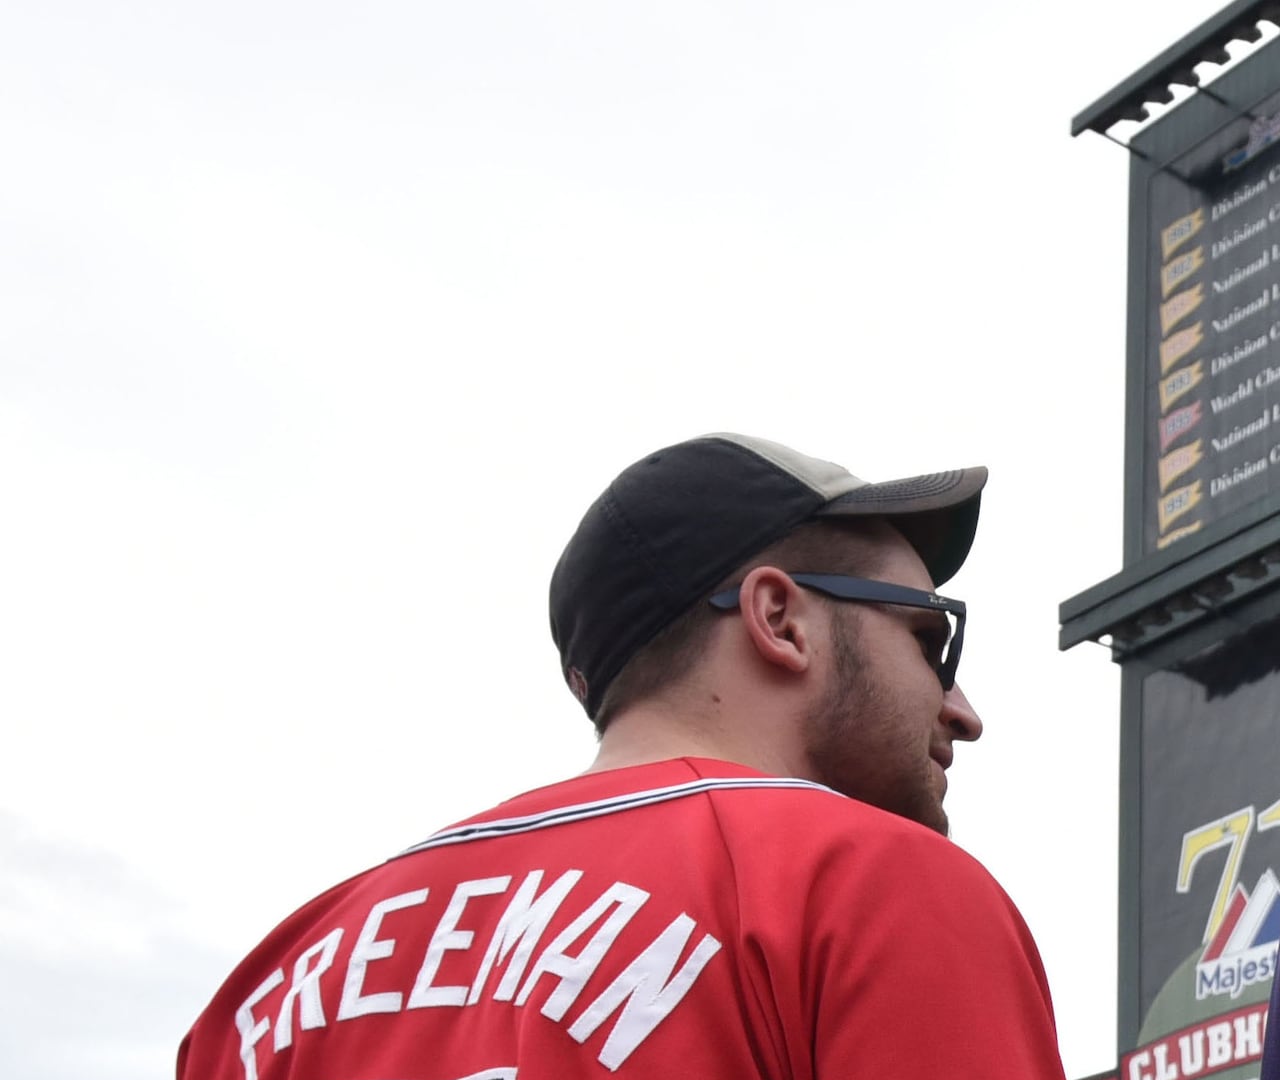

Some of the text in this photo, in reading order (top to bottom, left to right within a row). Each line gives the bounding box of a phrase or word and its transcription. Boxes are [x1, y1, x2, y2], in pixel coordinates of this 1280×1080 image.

[1212, 179, 1267, 222] Division
[1212, 218, 1267, 259] Division
[1213, 249, 1269, 293] National
[1212, 288, 1269, 332] National
[1211, 335, 1268, 376] Division
[1210, 378, 1253, 414] World
[1212, 409, 1269, 452] National
[1210, 457, 1268, 497] Division
